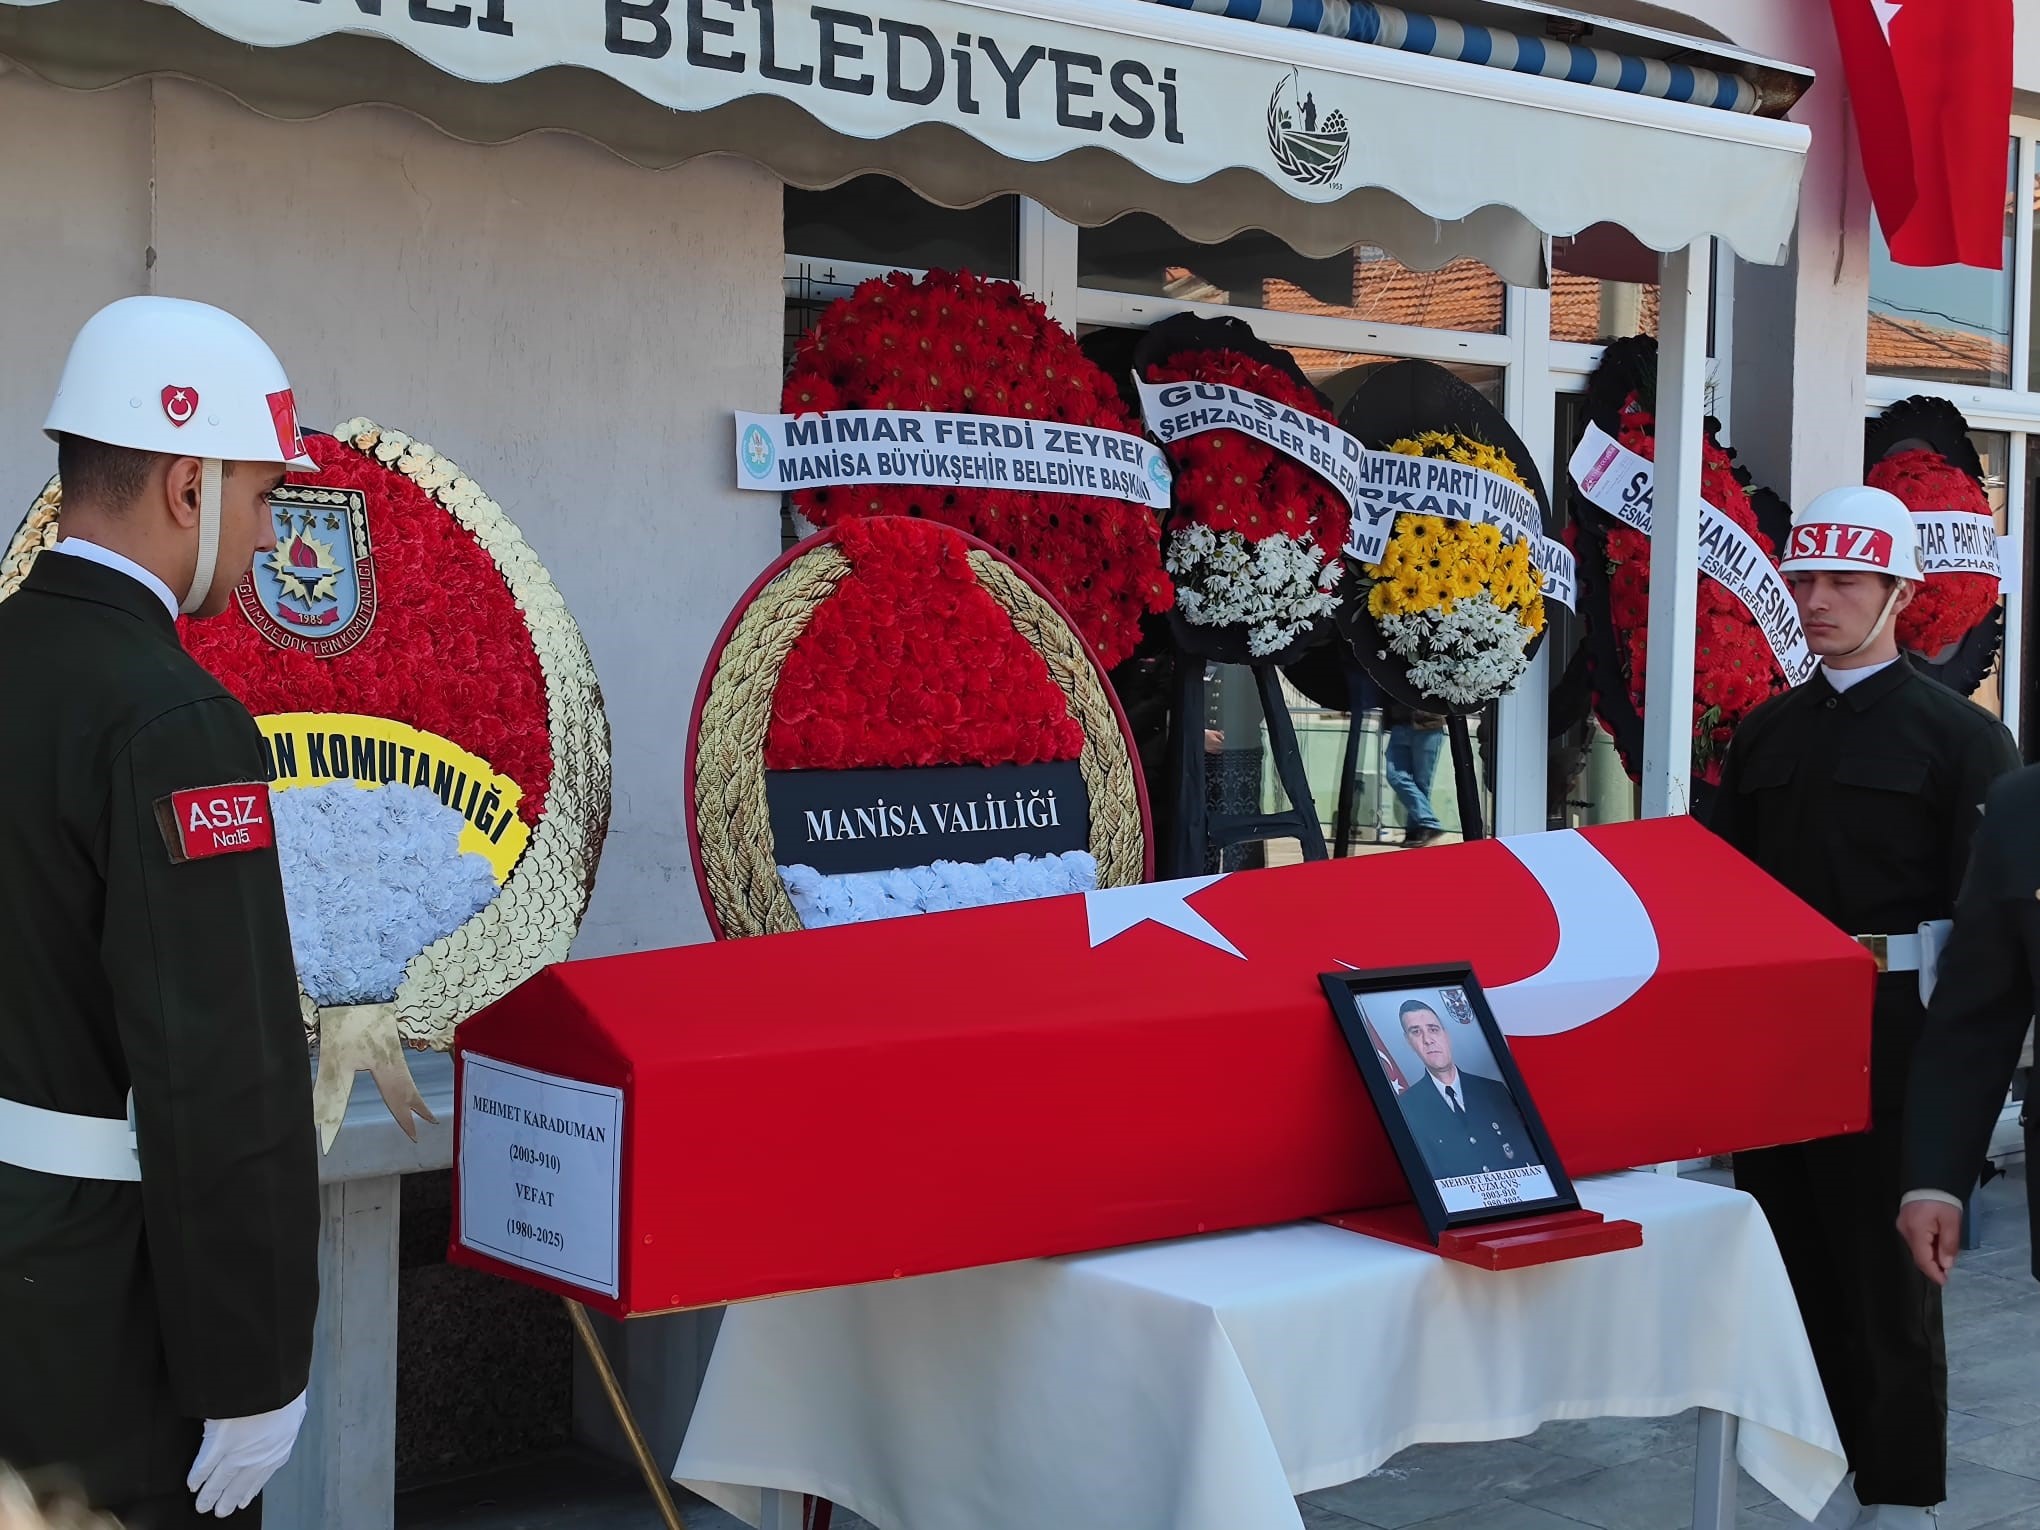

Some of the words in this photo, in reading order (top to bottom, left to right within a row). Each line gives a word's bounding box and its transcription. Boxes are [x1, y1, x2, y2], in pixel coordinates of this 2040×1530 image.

[604, 0, 1185, 144] BELEDİYESİ
[1159, 382, 1331, 443] GÜLŞAH
[1160, 408, 1304, 457] ŞEHZADELER
[785, 414, 924, 447] MİMAR
[935, 420, 1035, 450] FERDİ
[1044, 428, 1143, 469] ZEYREK
[778, 448, 872, 482] MANİSA
[877, 448, 1008, 484] BÜYÜKŞEHİR
[1013, 458, 1097, 489] BELEDİYE
[1100, 467, 1151, 501] BAŞKANI
[1427, 464, 1478, 499] PARTİ
[1952, 517, 1982, 556] PARTİ
[1701, 557, 1740, 587] ESNAF
[1738, 583, 1772, 627] KEFALET
[1755, 573, 1803, 651] ESNAF
[307, 732, 514, 845] KOMUTANLIĞI
[804, 798, 928, 842] MANİSA
[929, 789, 1061, 833] VALİLİĞİ
[472, 1095, 522, 1123] MEHMET
[524, 1110, 605, 1143] KARADUMAN
[509, 1143, 561, 1174] (2003-910)
[1440, 1175, 1482, 1190] MEHMET
[1484, 1166, 1543, 1184] KARADUMAN
[515, 1182, 555, 1208] VEFAT
[1481, 1187, 1517, 1201] 2003-910
[506, 1218, 564, 1251] (1980-2025)
